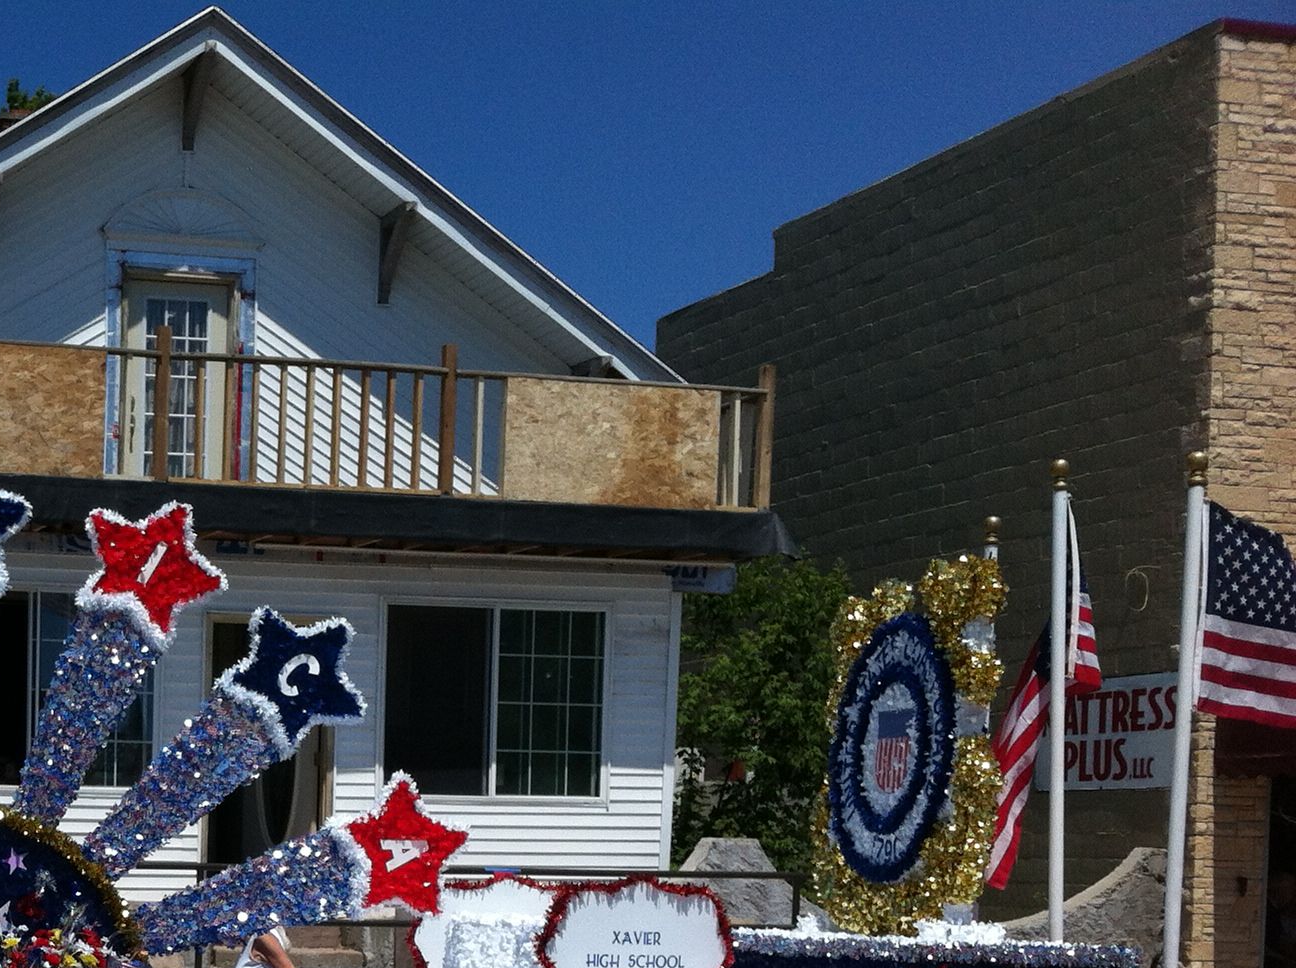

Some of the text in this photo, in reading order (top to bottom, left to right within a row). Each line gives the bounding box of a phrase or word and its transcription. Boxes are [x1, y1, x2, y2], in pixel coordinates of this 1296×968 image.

[136, 541, 168, 586] I
[277, 653, 320, 697] C
[380, 838, 429, 872] A
[1042, 686, 1177, 738] ATTRESS
[612, 930, 661, 945] XAVIER
[586, 953, 685, 968] HIGH SCHOOL
